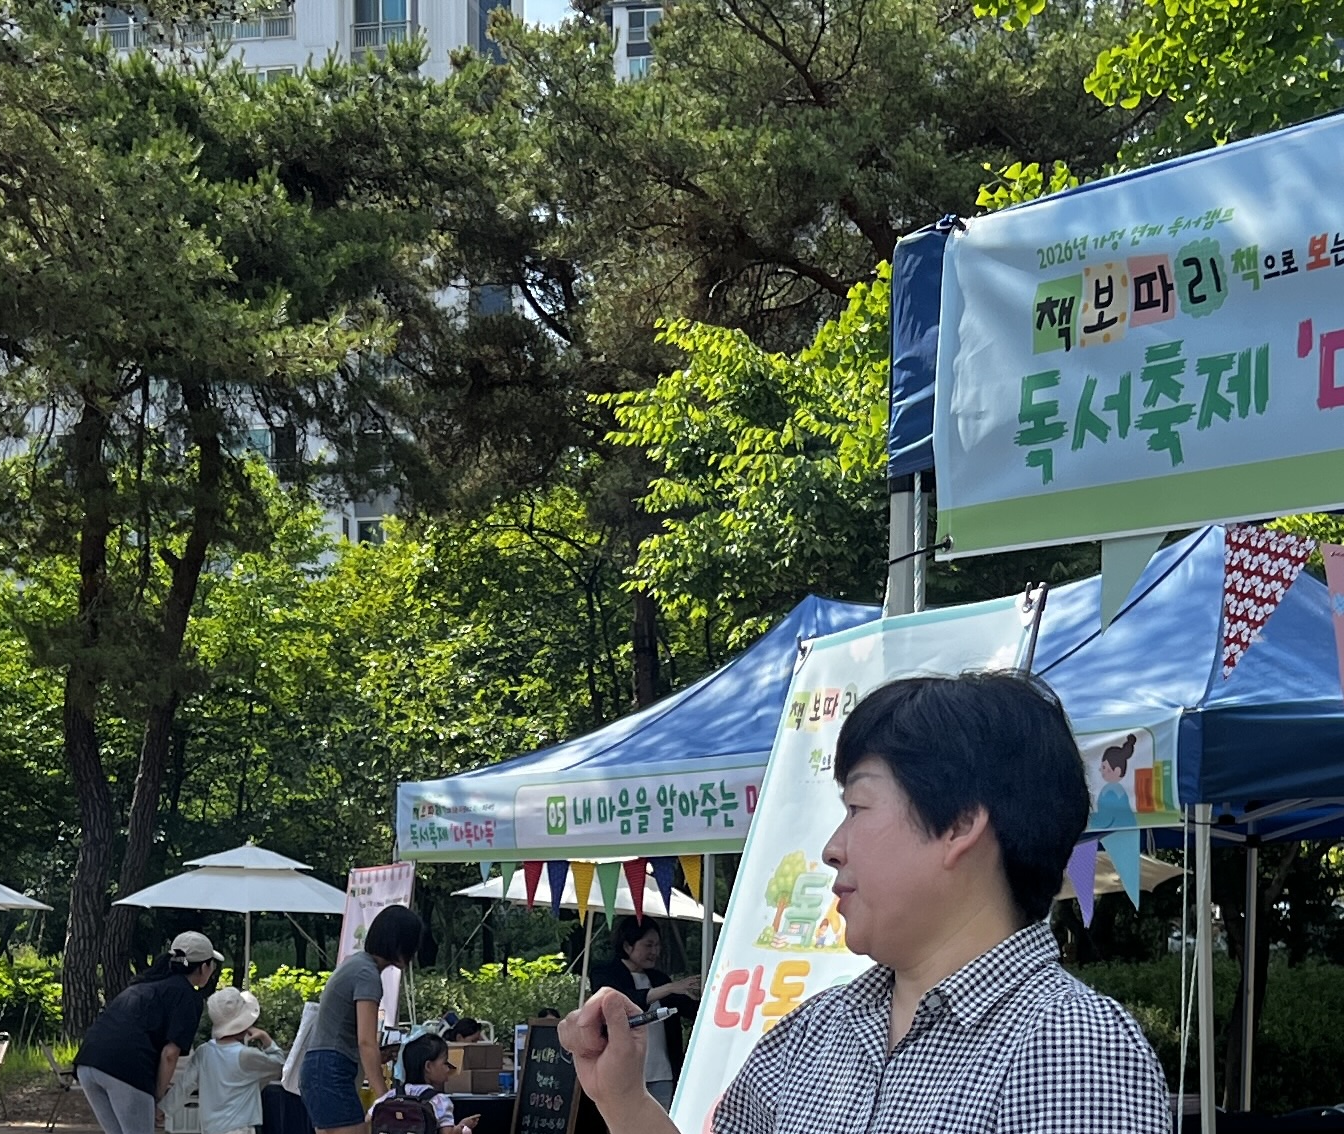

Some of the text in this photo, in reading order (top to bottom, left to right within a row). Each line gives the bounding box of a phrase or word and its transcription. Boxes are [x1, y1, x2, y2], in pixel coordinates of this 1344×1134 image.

[1037, 207, 1236, 270] 2026년 가정 연계 독서캠프
[1231, 243, 1298, 290] 책으로
[1014, 339, 1270, 485] 독서축제
[548, 799, 565, 829] 05
[573, 796, 592, 825] 내
[598, 785, 652, 835] 마음을
[657, 779, 739, 833] 알아주는
